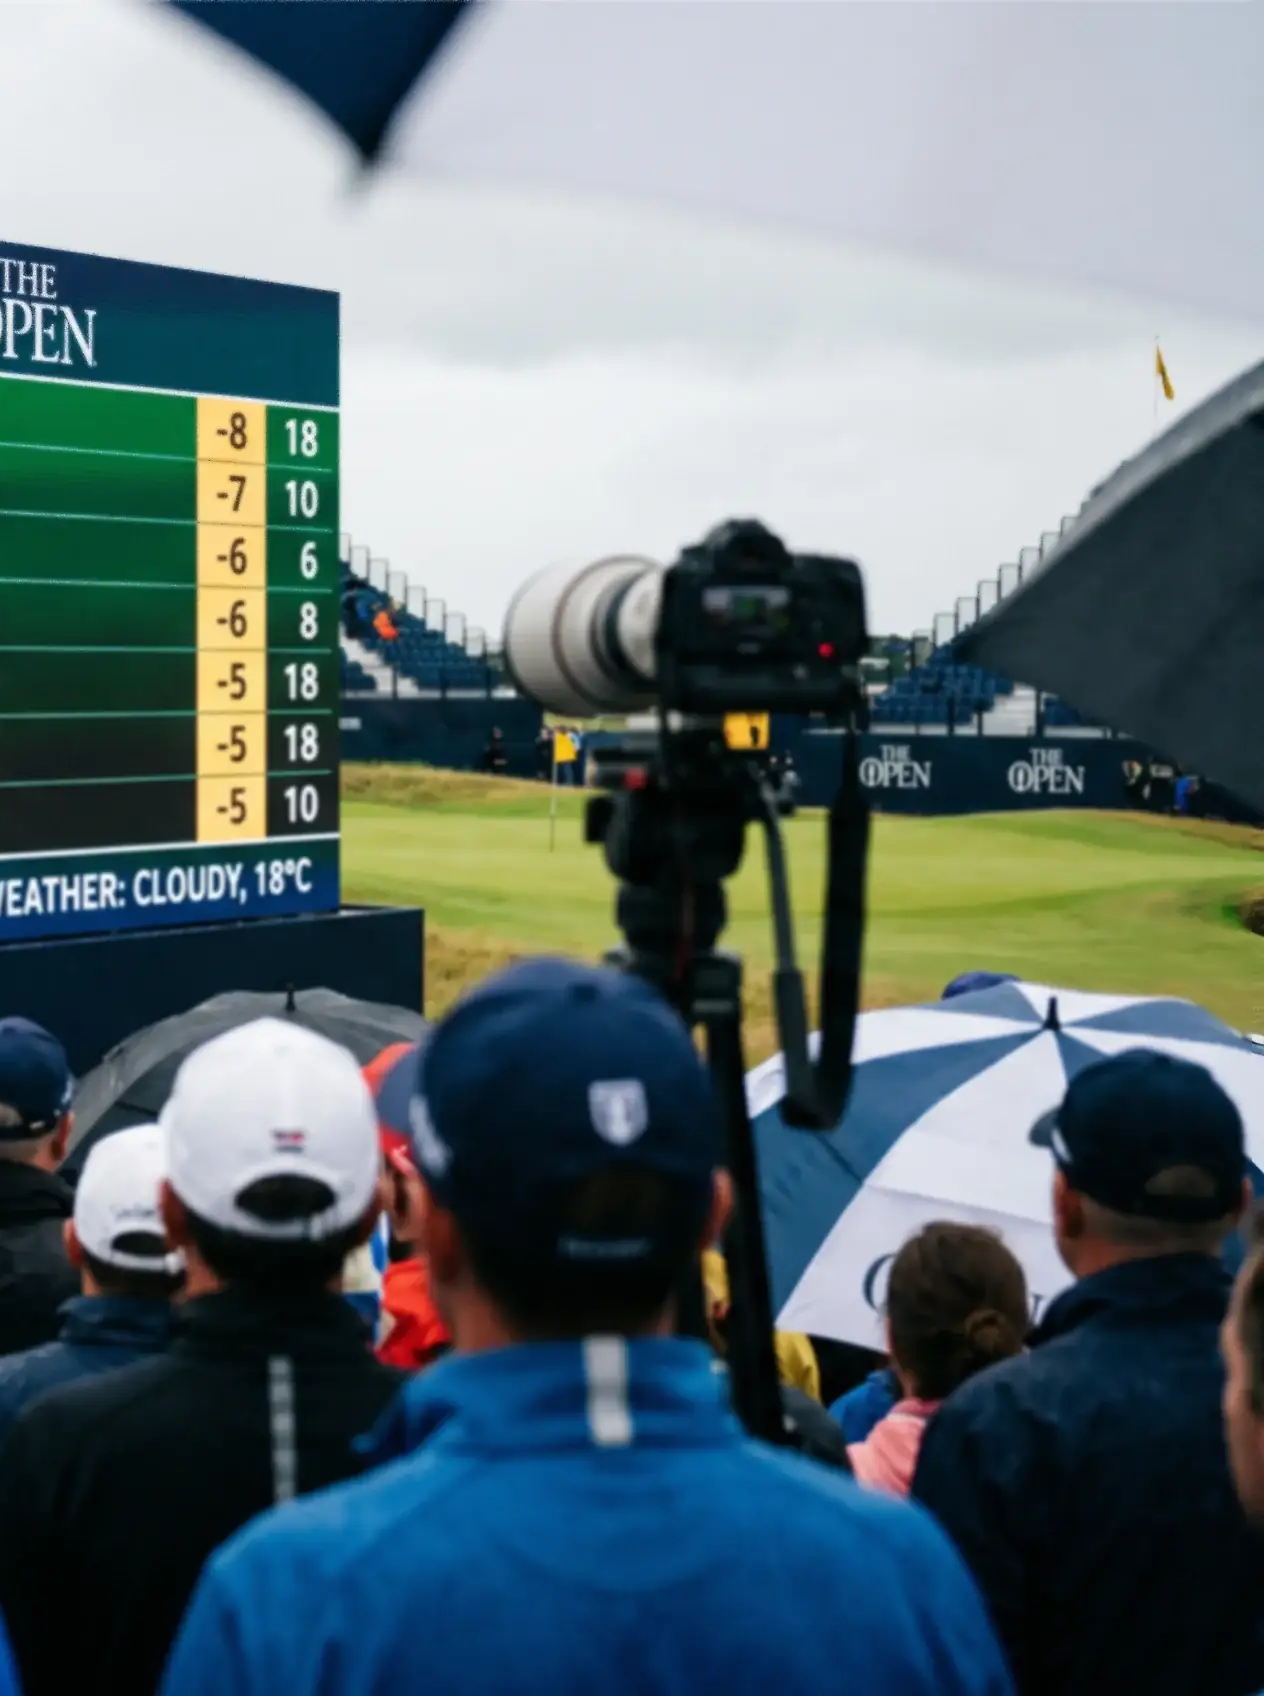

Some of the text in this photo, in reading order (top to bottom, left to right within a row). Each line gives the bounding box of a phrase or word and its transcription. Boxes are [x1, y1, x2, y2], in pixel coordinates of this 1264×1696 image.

[216, 411, 248, 451] -8
[284, 418, 319, 458] 18
[216, 474, 248, 513] -7
[285, 479, 319, 519] 10
[216, 537, 248, 576] -6
[300, 541, 319, 580] 6
[216, 599, 248, 639] -6
[299, 601, 319, 641] 8
[216, 662, 248, 701] -5
[284, 662, 319, 701] 18
[216, 724, 248, 764] -5
[284, 723, 319, 763] 18
[880, 744, 911, 763] THE
[1029, 748, 1064, 768] THE
[859, 757, 931, 789] OPEN
[1007, 761, 1085, 794] OPEN
[216, 786, 248, 826] -5
[284, 783, 319, 824] 10
[133, 862, 248, 905] CLOUDY,
[254, 856, 313, 897] 18°C
